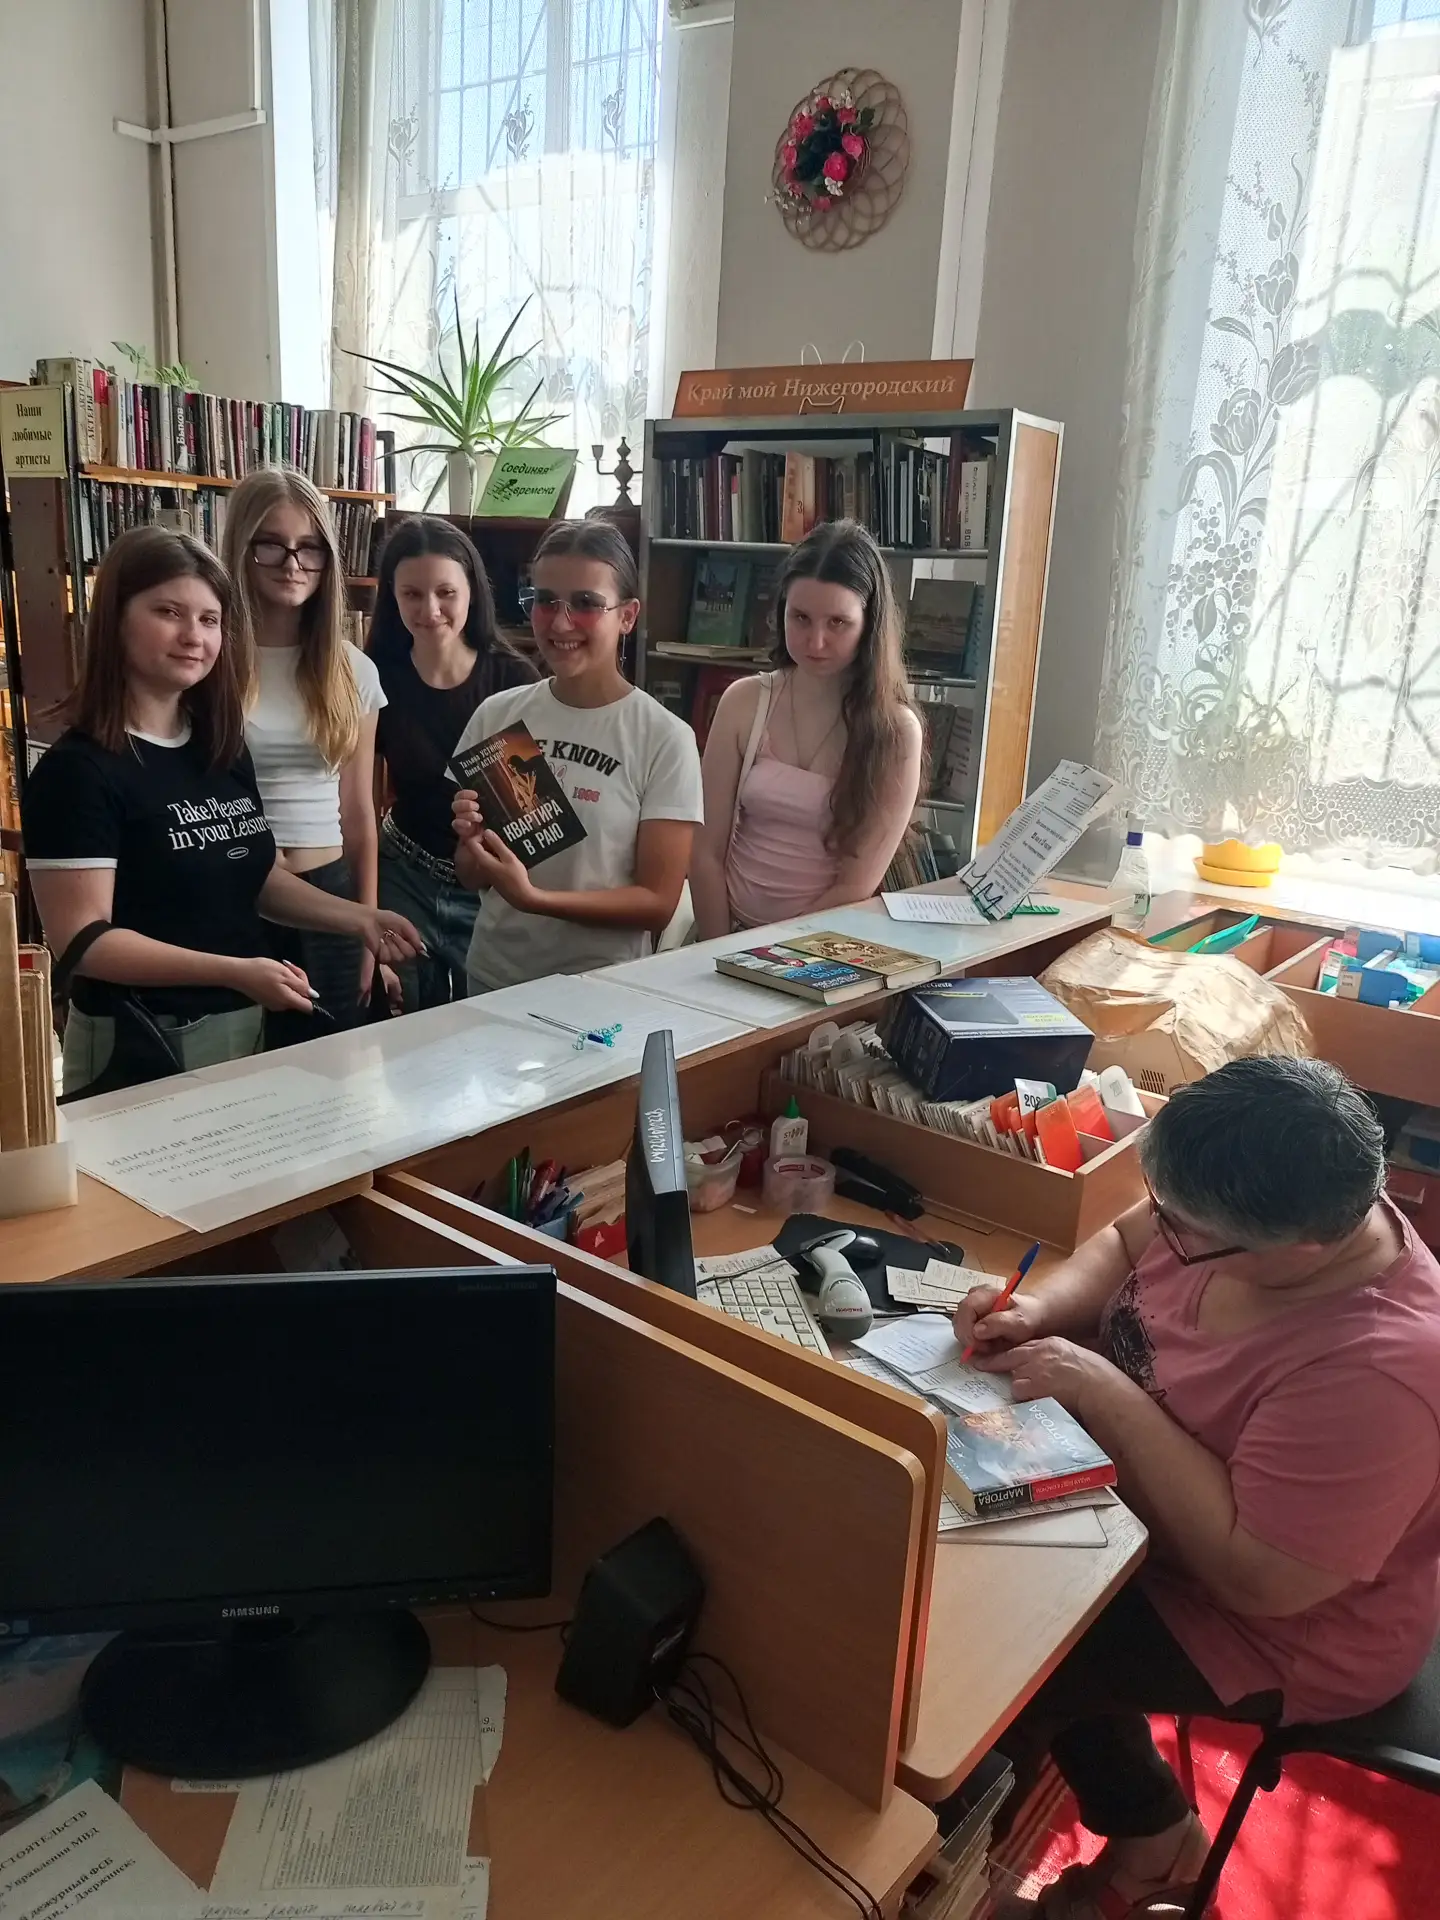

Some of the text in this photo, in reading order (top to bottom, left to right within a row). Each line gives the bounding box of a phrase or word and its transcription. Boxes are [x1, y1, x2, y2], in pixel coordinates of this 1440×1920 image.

[687, 376, 955, 406] Край мой Нижегородский
[16, 404, 42, 417] Наши
[12, 428, 52, 441] любимые
[15, 456, 51, 468] артисты
[501, 462, 550, 475] Соединяя
[513, 487, 555, 497] времена
[479, 738, 508, 759] УСТИНОВА
[550, 740, 622, 777] KNOW
[479, 749, 506, 772] АСТАХОВ
[166, 797, 256, 825] Take Pleasure
[502, 799, 564, 842] КВАРТИРА
[168, 815, 270, 850] in your Leisur
[522, 822, 564, 856] В РАЮ
[191, 1123, 245, 1142] ШТРАФ
[170, 1139, 189, 1149] 30
[189, 1168, 214, 1178] что
[1029, 1404, 1081, 1459] МАРТОВА
[978, 1486, 1024, 1507] МАРТОВА
[221, 1605, 280, 1618] SAMSUNG
[0, 1809, 88, 1872] СТОЯТЕЛЬСТВ
[71, 1826, 100, 1848] МВД
[31, 1856, 114, 1917] дежурный ФСБ
